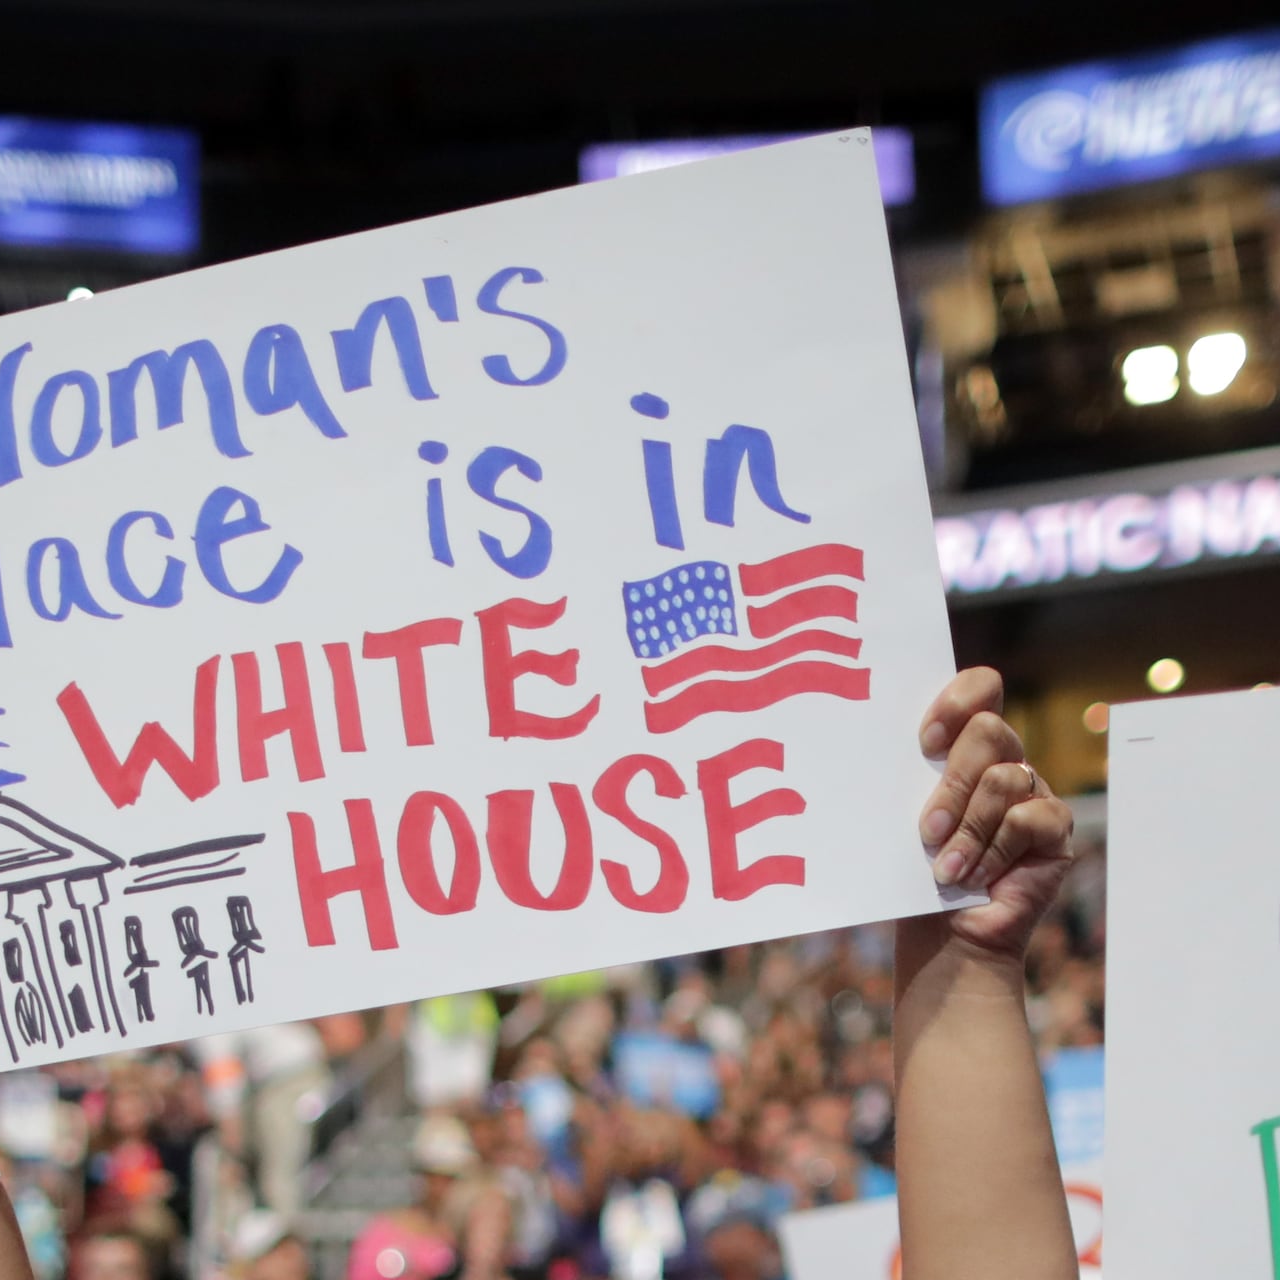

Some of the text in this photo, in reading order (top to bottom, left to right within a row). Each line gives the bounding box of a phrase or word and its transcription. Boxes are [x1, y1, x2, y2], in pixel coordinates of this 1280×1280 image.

[417, 440, 552, 580] is
[629, 392, 811, 551] in
[932, 492, 1163, 594] RATIC
[56, 596, 601, 809] WHITE
[286, 737, 807, 952] HOUSE
